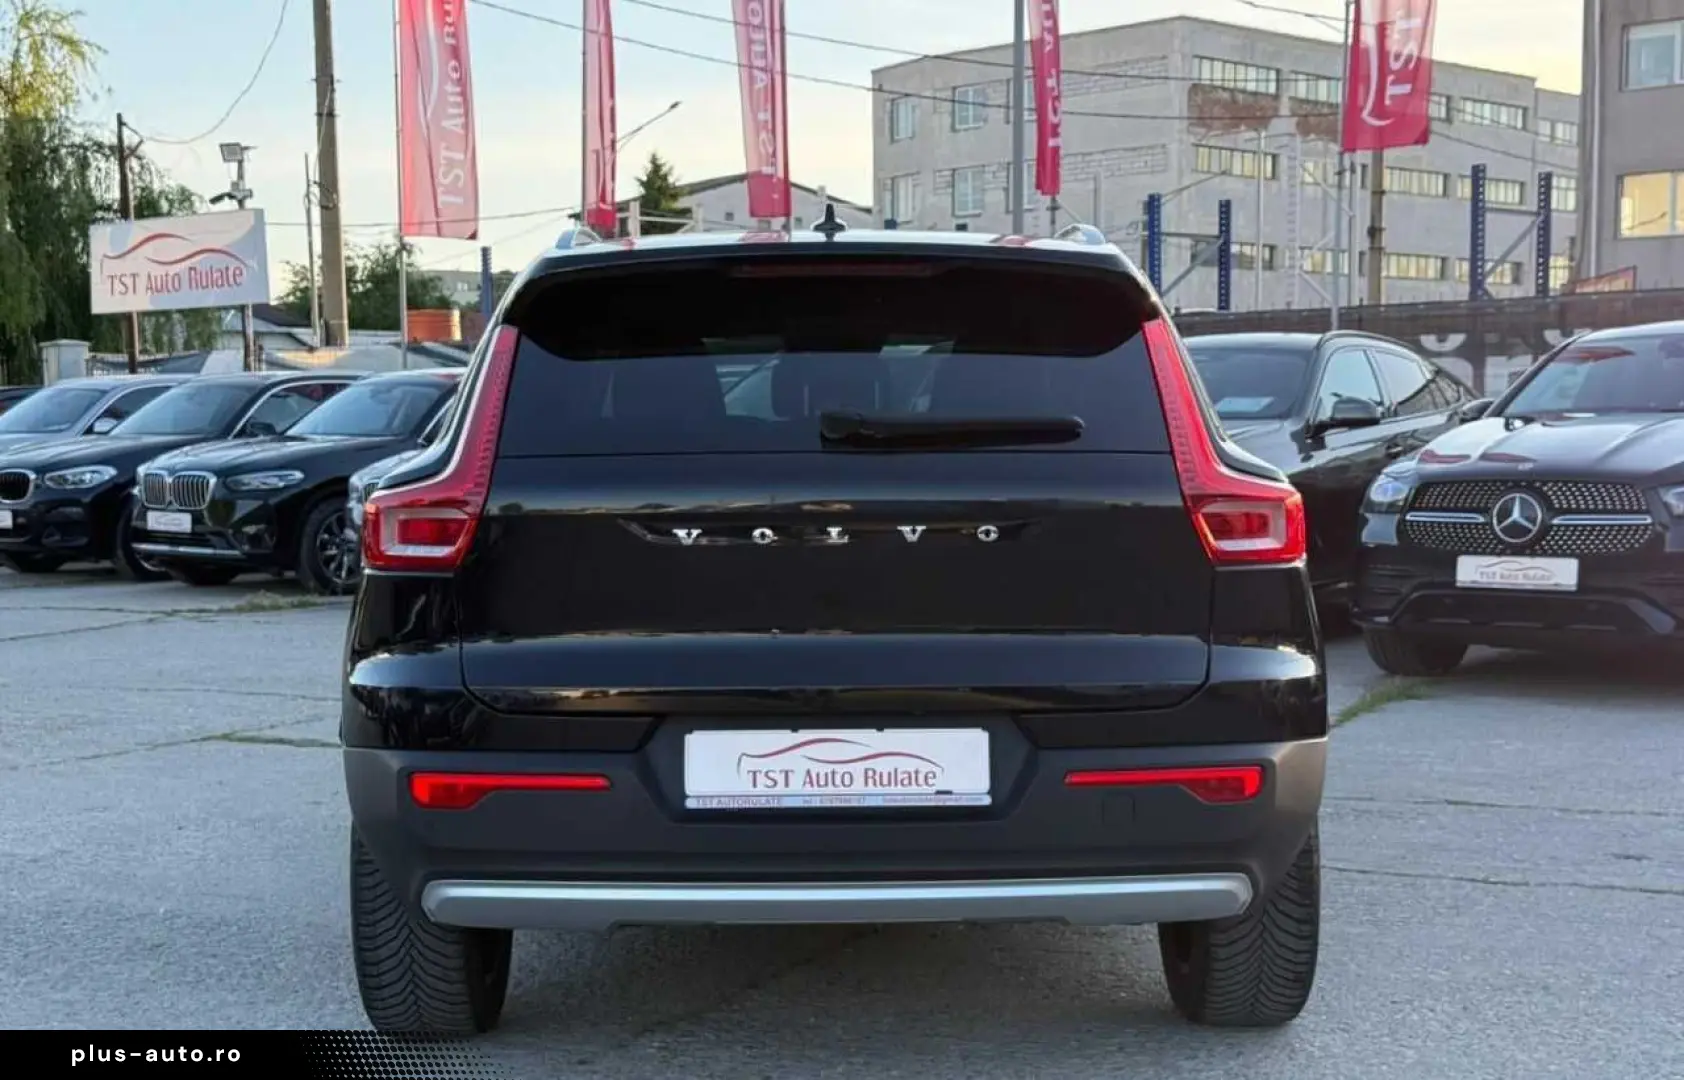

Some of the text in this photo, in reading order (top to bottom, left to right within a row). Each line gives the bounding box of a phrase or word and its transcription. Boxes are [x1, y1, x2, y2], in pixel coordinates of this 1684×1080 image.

[1384, 10, 1422, 106] TST
[442, 60, 465, 134] Auto
[437, 143, 465, 209] TST
[107, 264, 243, 296] TST Auto Rulate
[672, 525, 1000, 545] VOLVO
[747, 767, 938, 789] TST Auto Rulate
